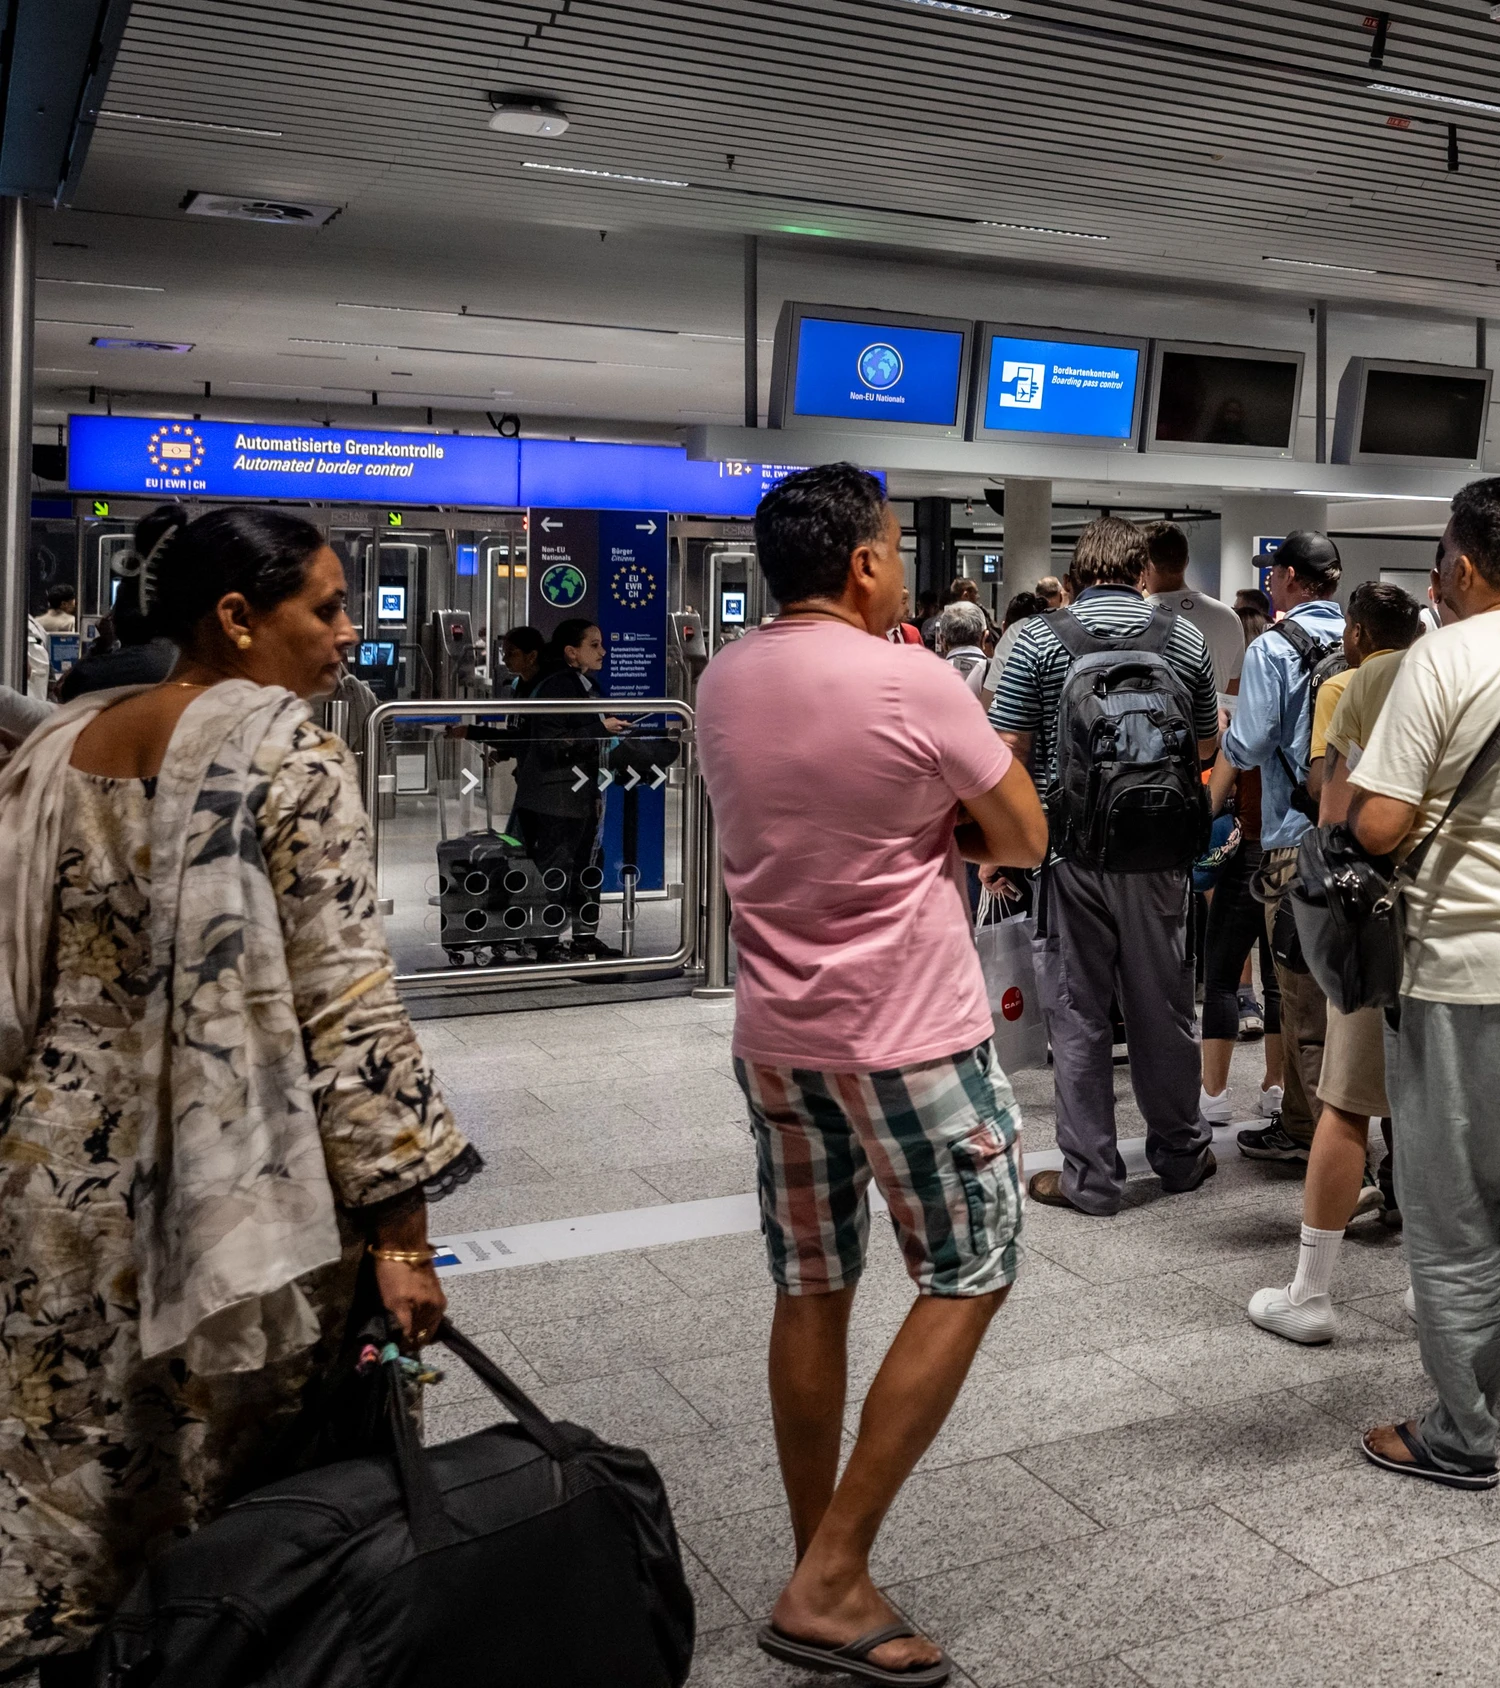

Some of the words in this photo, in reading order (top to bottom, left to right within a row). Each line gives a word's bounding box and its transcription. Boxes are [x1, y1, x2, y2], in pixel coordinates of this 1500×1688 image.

[1053, 364, 1120, 380] Bordkartenkontrolle
[1051, 375, 1082, 388] Boarding
[1082, 379, 1099, 388] pass
[1099, 381, 1124, 389] control
[850, 391, 875, 401] Non-EU
[876, 393, 906, 404] Nationals
[234, 433, 341, 454] Automatisierte
[345, 439, 444, 459] Grenzkontrolle
[233, 454, 314, 473] Automated
[316, 458, 363, 475] border
[364, 462, 414, 477] control
[145, 478, 158, 488] EU
[165, 479, 186, 489] EWR
[193, 480, 206, 490] CH
[541, 545, 566, 554] Non-EU
[611, 547, 633, 556] Bürger
[541, 553, 571, 562] Nationals
[628, 574, 639, 582] EU
[625, 582, 643, 590] EWR
[628, 590, 639, 598] CH
